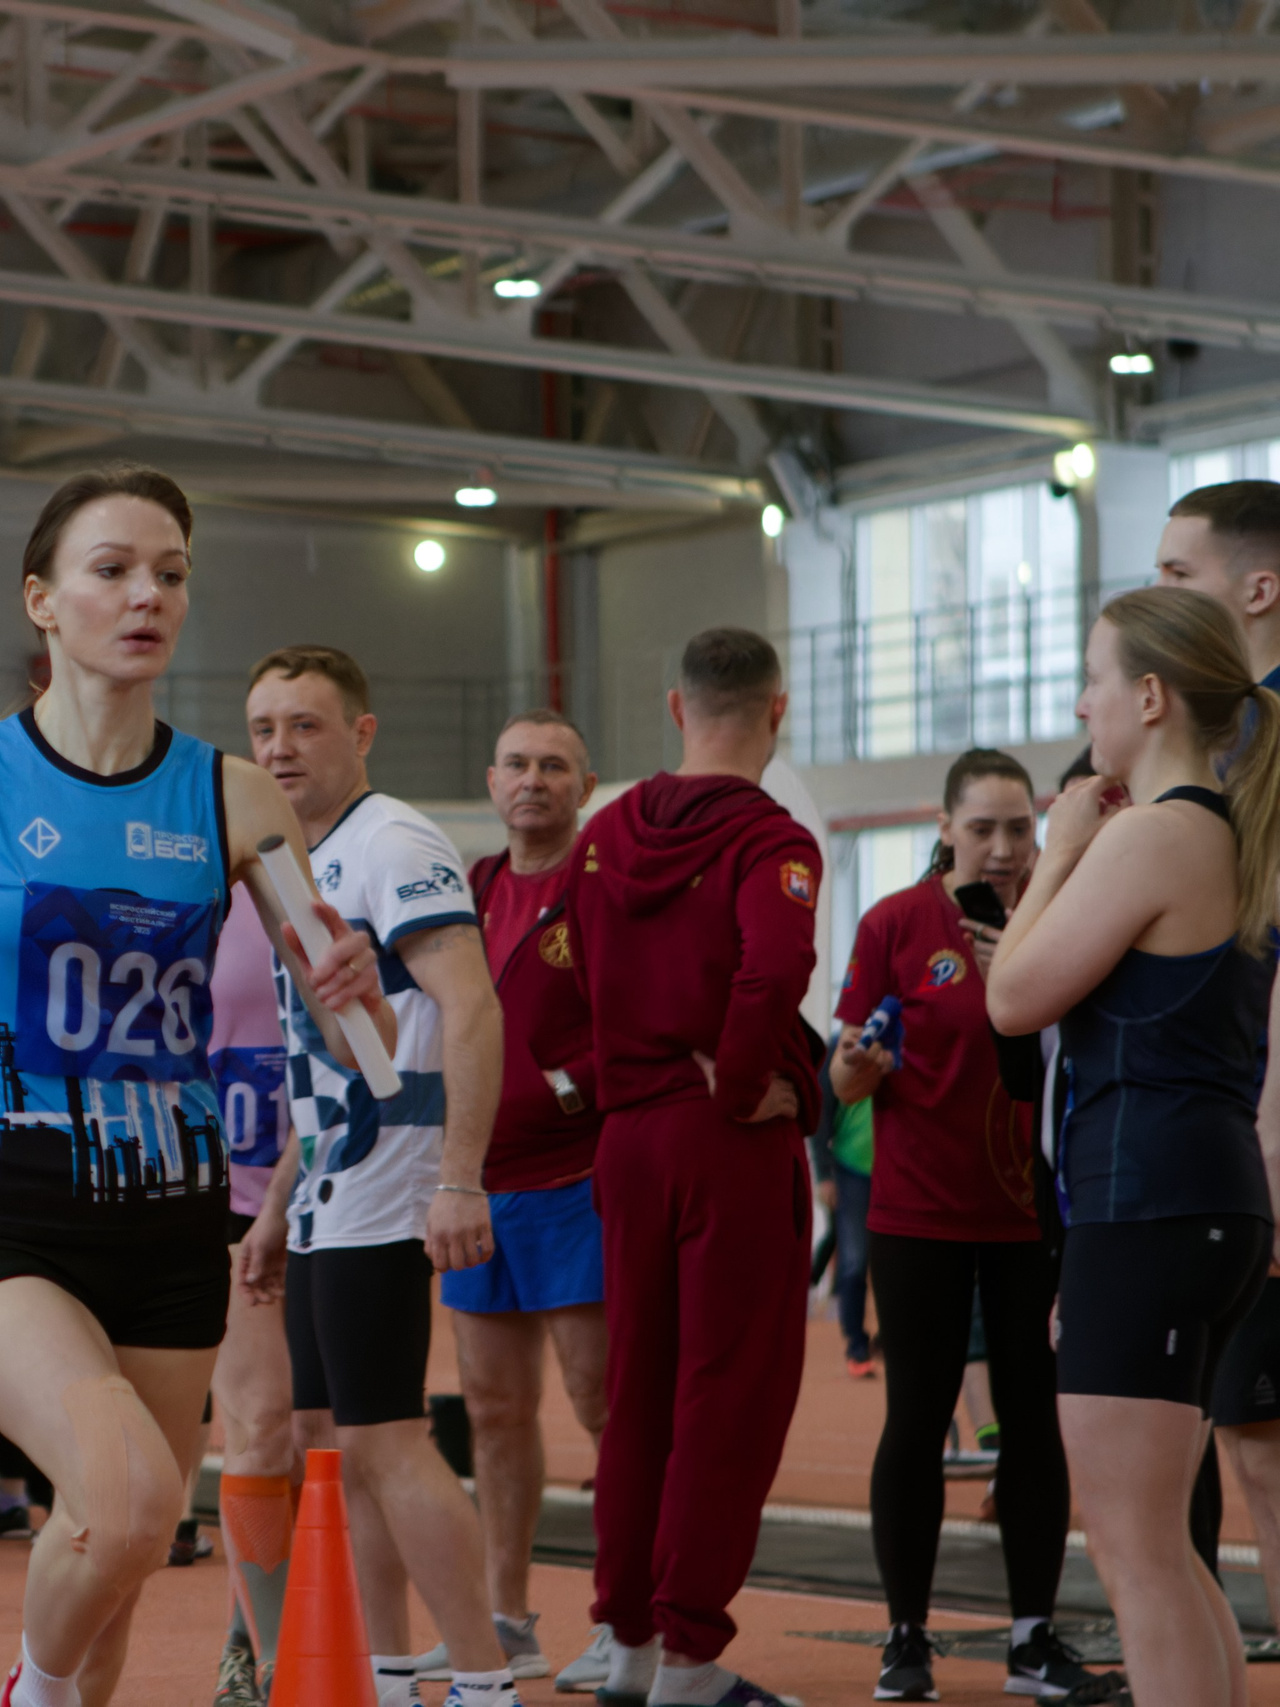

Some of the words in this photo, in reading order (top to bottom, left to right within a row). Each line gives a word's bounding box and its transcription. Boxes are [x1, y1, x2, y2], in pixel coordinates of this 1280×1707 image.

[155, 840, 208, 863] БСК
[396, 880, 440, 899] БСК
[46, 942, 206, 1056] 026
